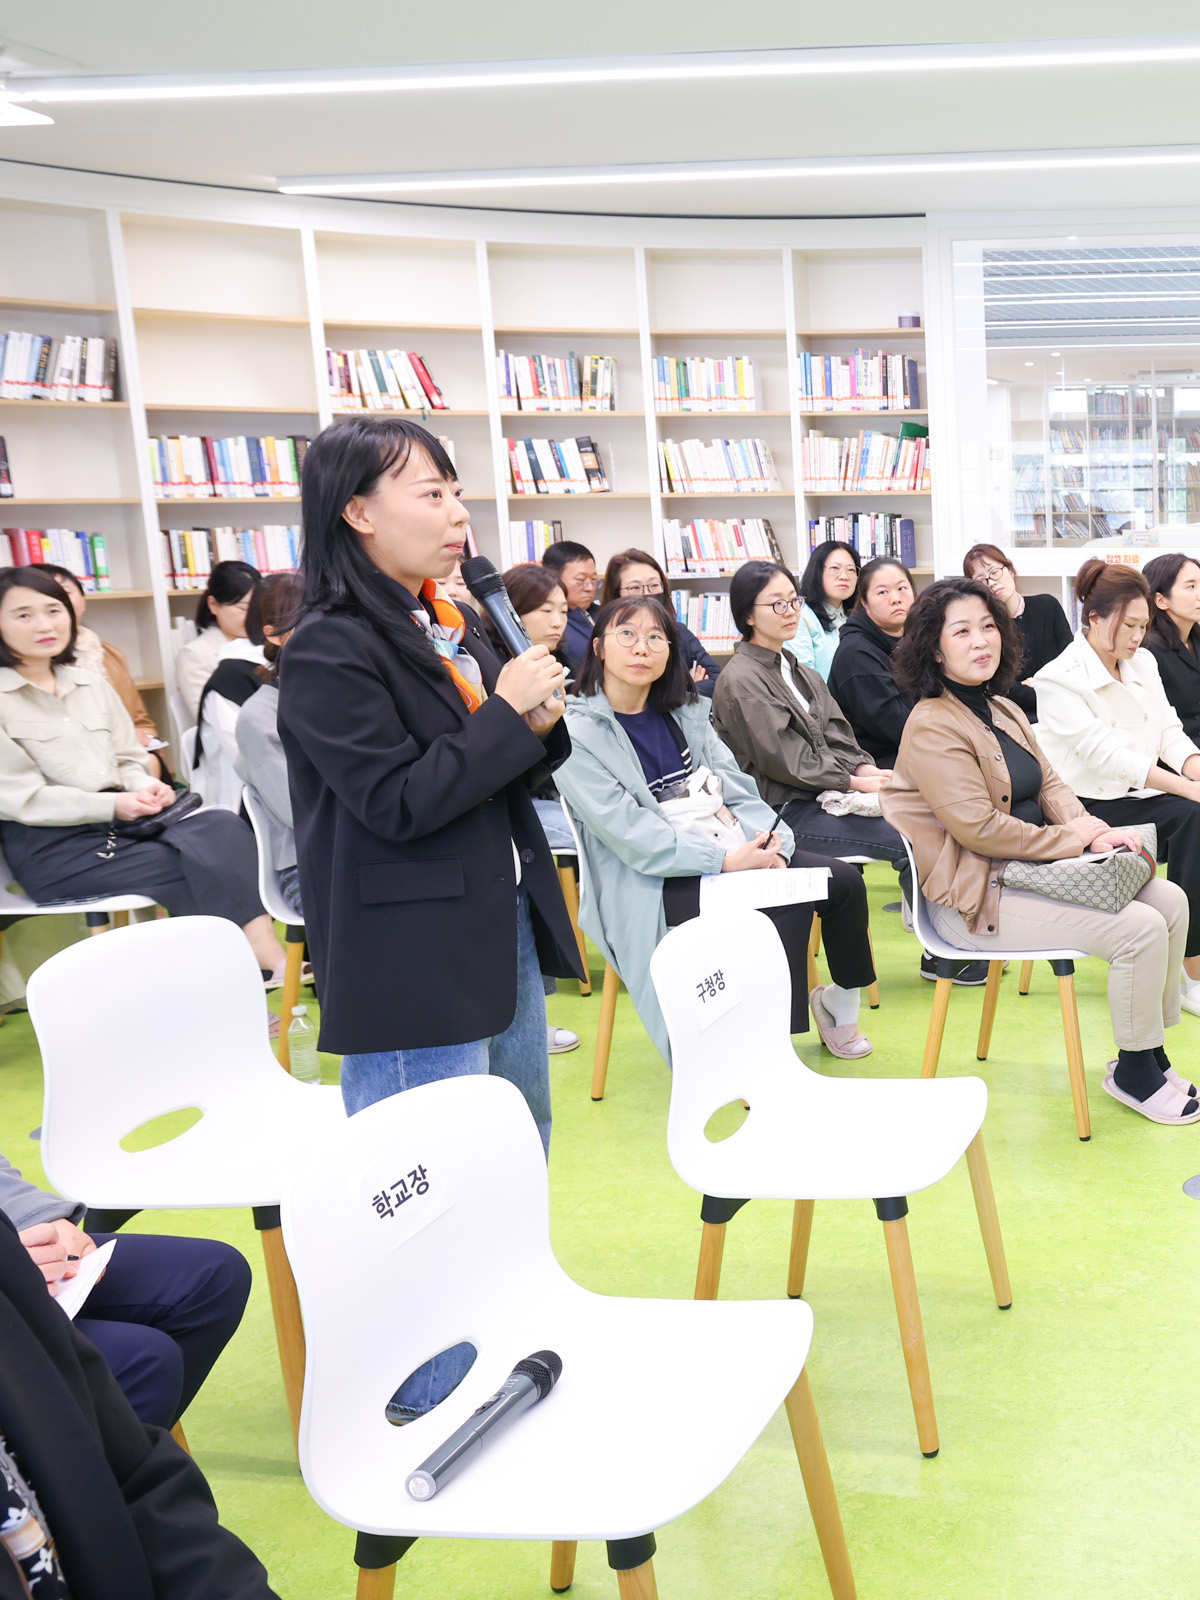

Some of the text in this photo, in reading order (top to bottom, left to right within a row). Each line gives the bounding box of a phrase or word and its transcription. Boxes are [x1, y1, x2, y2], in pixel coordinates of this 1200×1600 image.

[1122, 554, 1139, 564] 자료
[695, 969, 726, 1004] 구청장
[371, 1164, 430, 1219] 학교장
